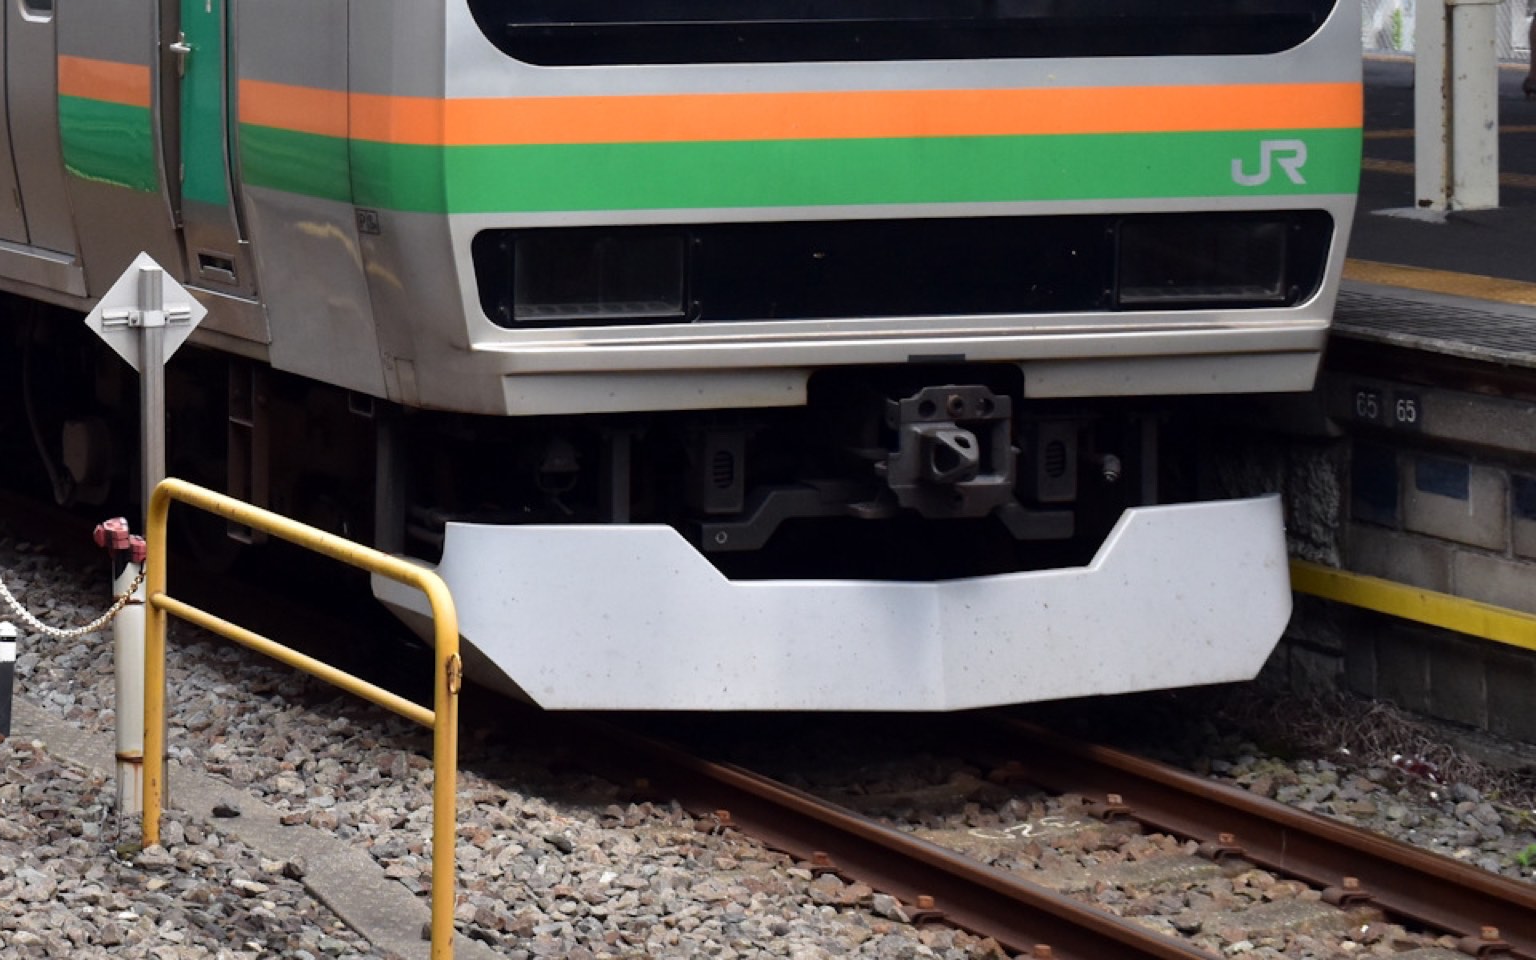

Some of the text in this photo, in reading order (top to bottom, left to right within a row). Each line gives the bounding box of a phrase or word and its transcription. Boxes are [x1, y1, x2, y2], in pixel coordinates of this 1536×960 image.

[1231, 139, 1307, 186] JR
[1357, 392, 1378, 419] 65
[1396, 399, 1416, 423] 65
